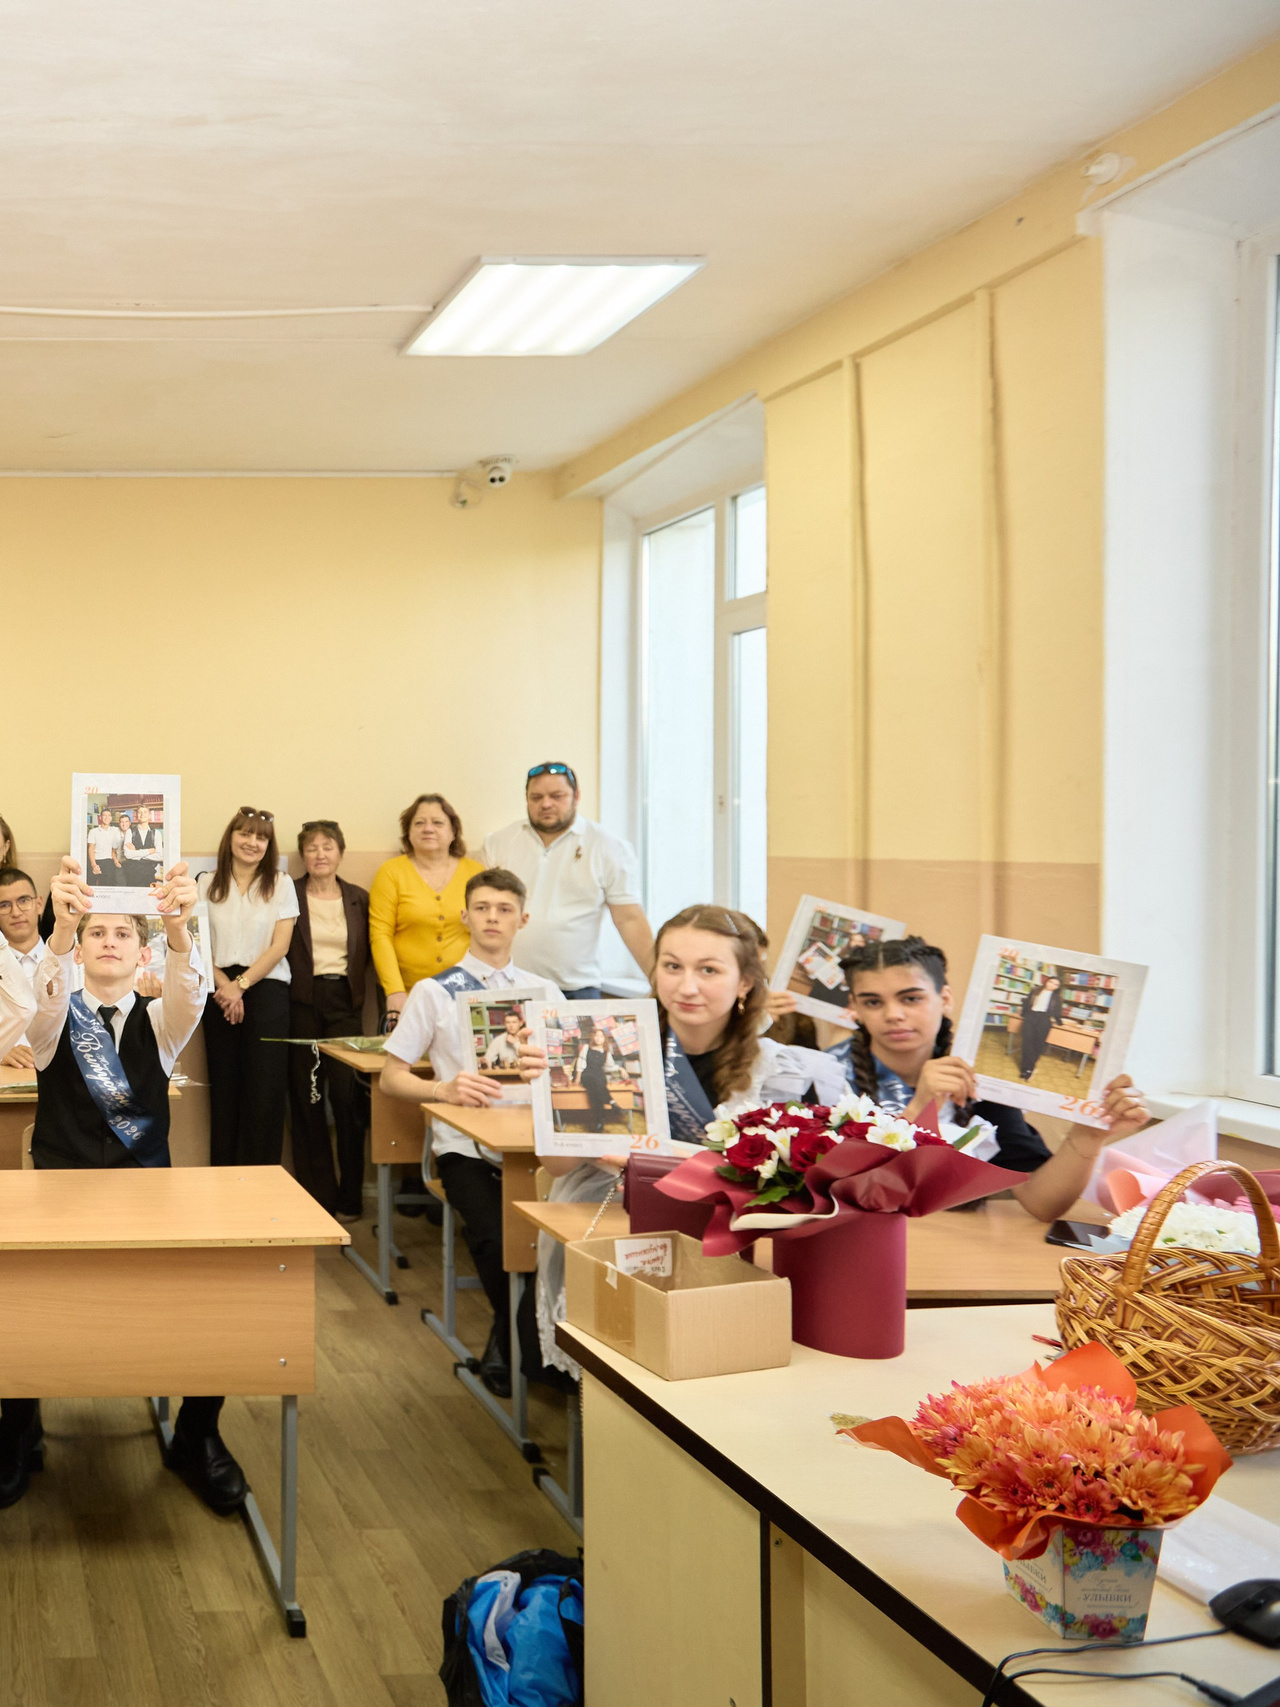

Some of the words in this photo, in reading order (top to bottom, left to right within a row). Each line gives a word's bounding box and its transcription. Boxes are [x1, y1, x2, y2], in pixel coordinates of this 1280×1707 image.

[84, 786, 99, 795] 20
[148, 882, 162, 897] 2
[1059, 1095, 1099, 1117] 26
[109, 1115, 146, 1142] 2026
[630, 1133, 659, 1151] 26
[1018, 1559, 1047, 1584] ЛЫБКИ
